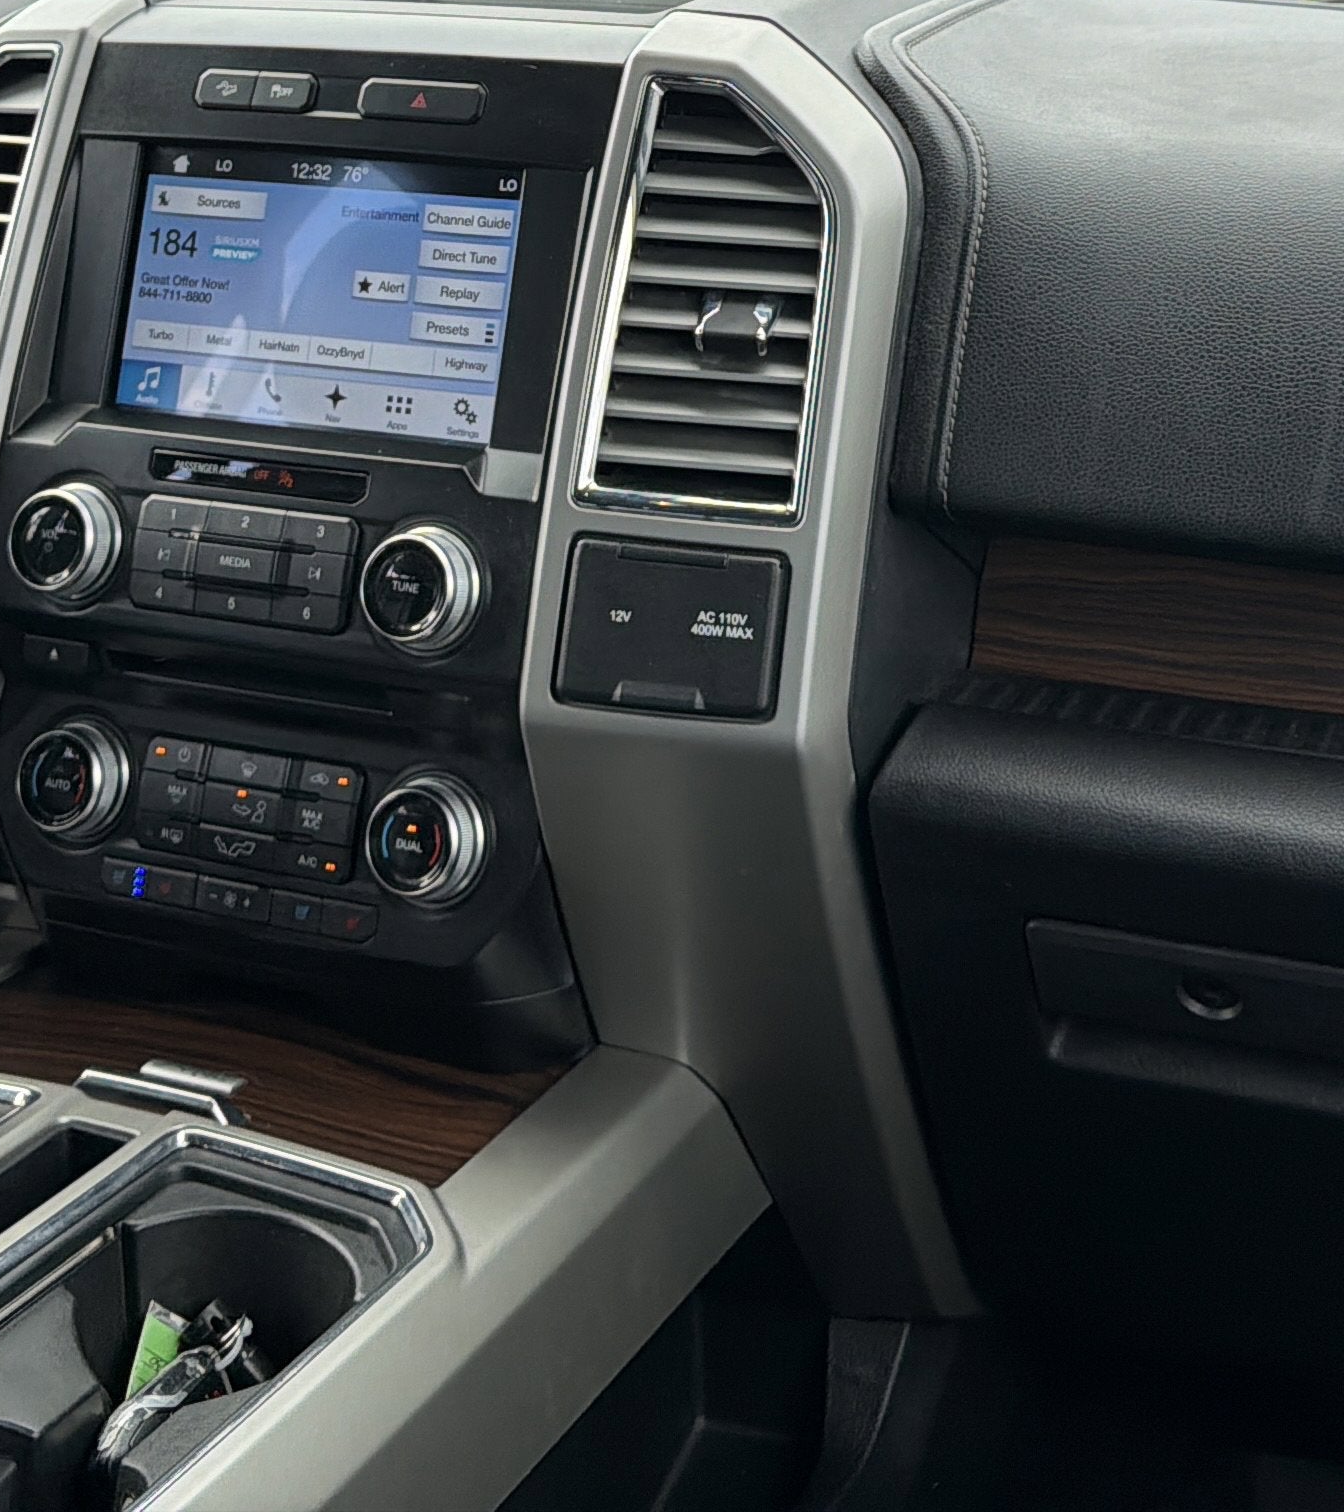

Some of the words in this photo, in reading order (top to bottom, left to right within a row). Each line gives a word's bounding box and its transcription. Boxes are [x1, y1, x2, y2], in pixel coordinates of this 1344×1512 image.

[215, 158, 233, 174] LO
[291, 162, 333, 181] 12:32
[499, 177, 519, 193] LO
[196, 194, 241, 210] Sources
[341, 204, 420, 225] Entertainment
[427, 210, 474, 229] Channel
[477, 214, 512, 232] Guide
[147, 226, 199, 259] 184
[431, 248, 466, 264] Direct
[468, 250, 497, 266] Tune
[141, 271, 170, 289] Great
[172, 274, 200, 290] Offer
[201, 276, 230, 292] Now!
[378, 279, 406, 296] Alert
[138, 286, 213, 305] 844-711-8800
[440, 287, 480, 305] Replay
[425, 320, 470, 338] Presets
[148, 329, 175, 343] Turbo
[206, 333, 232, 348] Metal
[258, 338, 300, 355] HairNatn
[316, 344, 366, 362] OzzyBnyd
[444, 355, 488, 374] Highway
[324, 413, 342, 424] Nav
[386, 420, 409, 434] Apps
[446, 426, 480, 441] Settings
[173, 458, 219, 475] PASSENGER
[241, 514, 250, 528] 2
[316, 524, 326, 539] 3
[219, 554, 252, 569] MEDIA
[155, 585, 163, 599] 4
[392, 579, 420, 595] TUNE
[227, 596, 236, 610] 5
[302, 606, 311, 621] 6
[610, 609, 632, 623] 12V
[697, 610, 716, 623] AC
[718, 612, 749, 626] 110V
[690, 623, 724, 637] 400W
[725, 626, 754, 640] MAX
[44, 777, 71, 792] AUTO
[301, 807, 324, 821] MAX
[395, 837, 423, 854] DUAL
[298, 854, 318, 869] A/C
